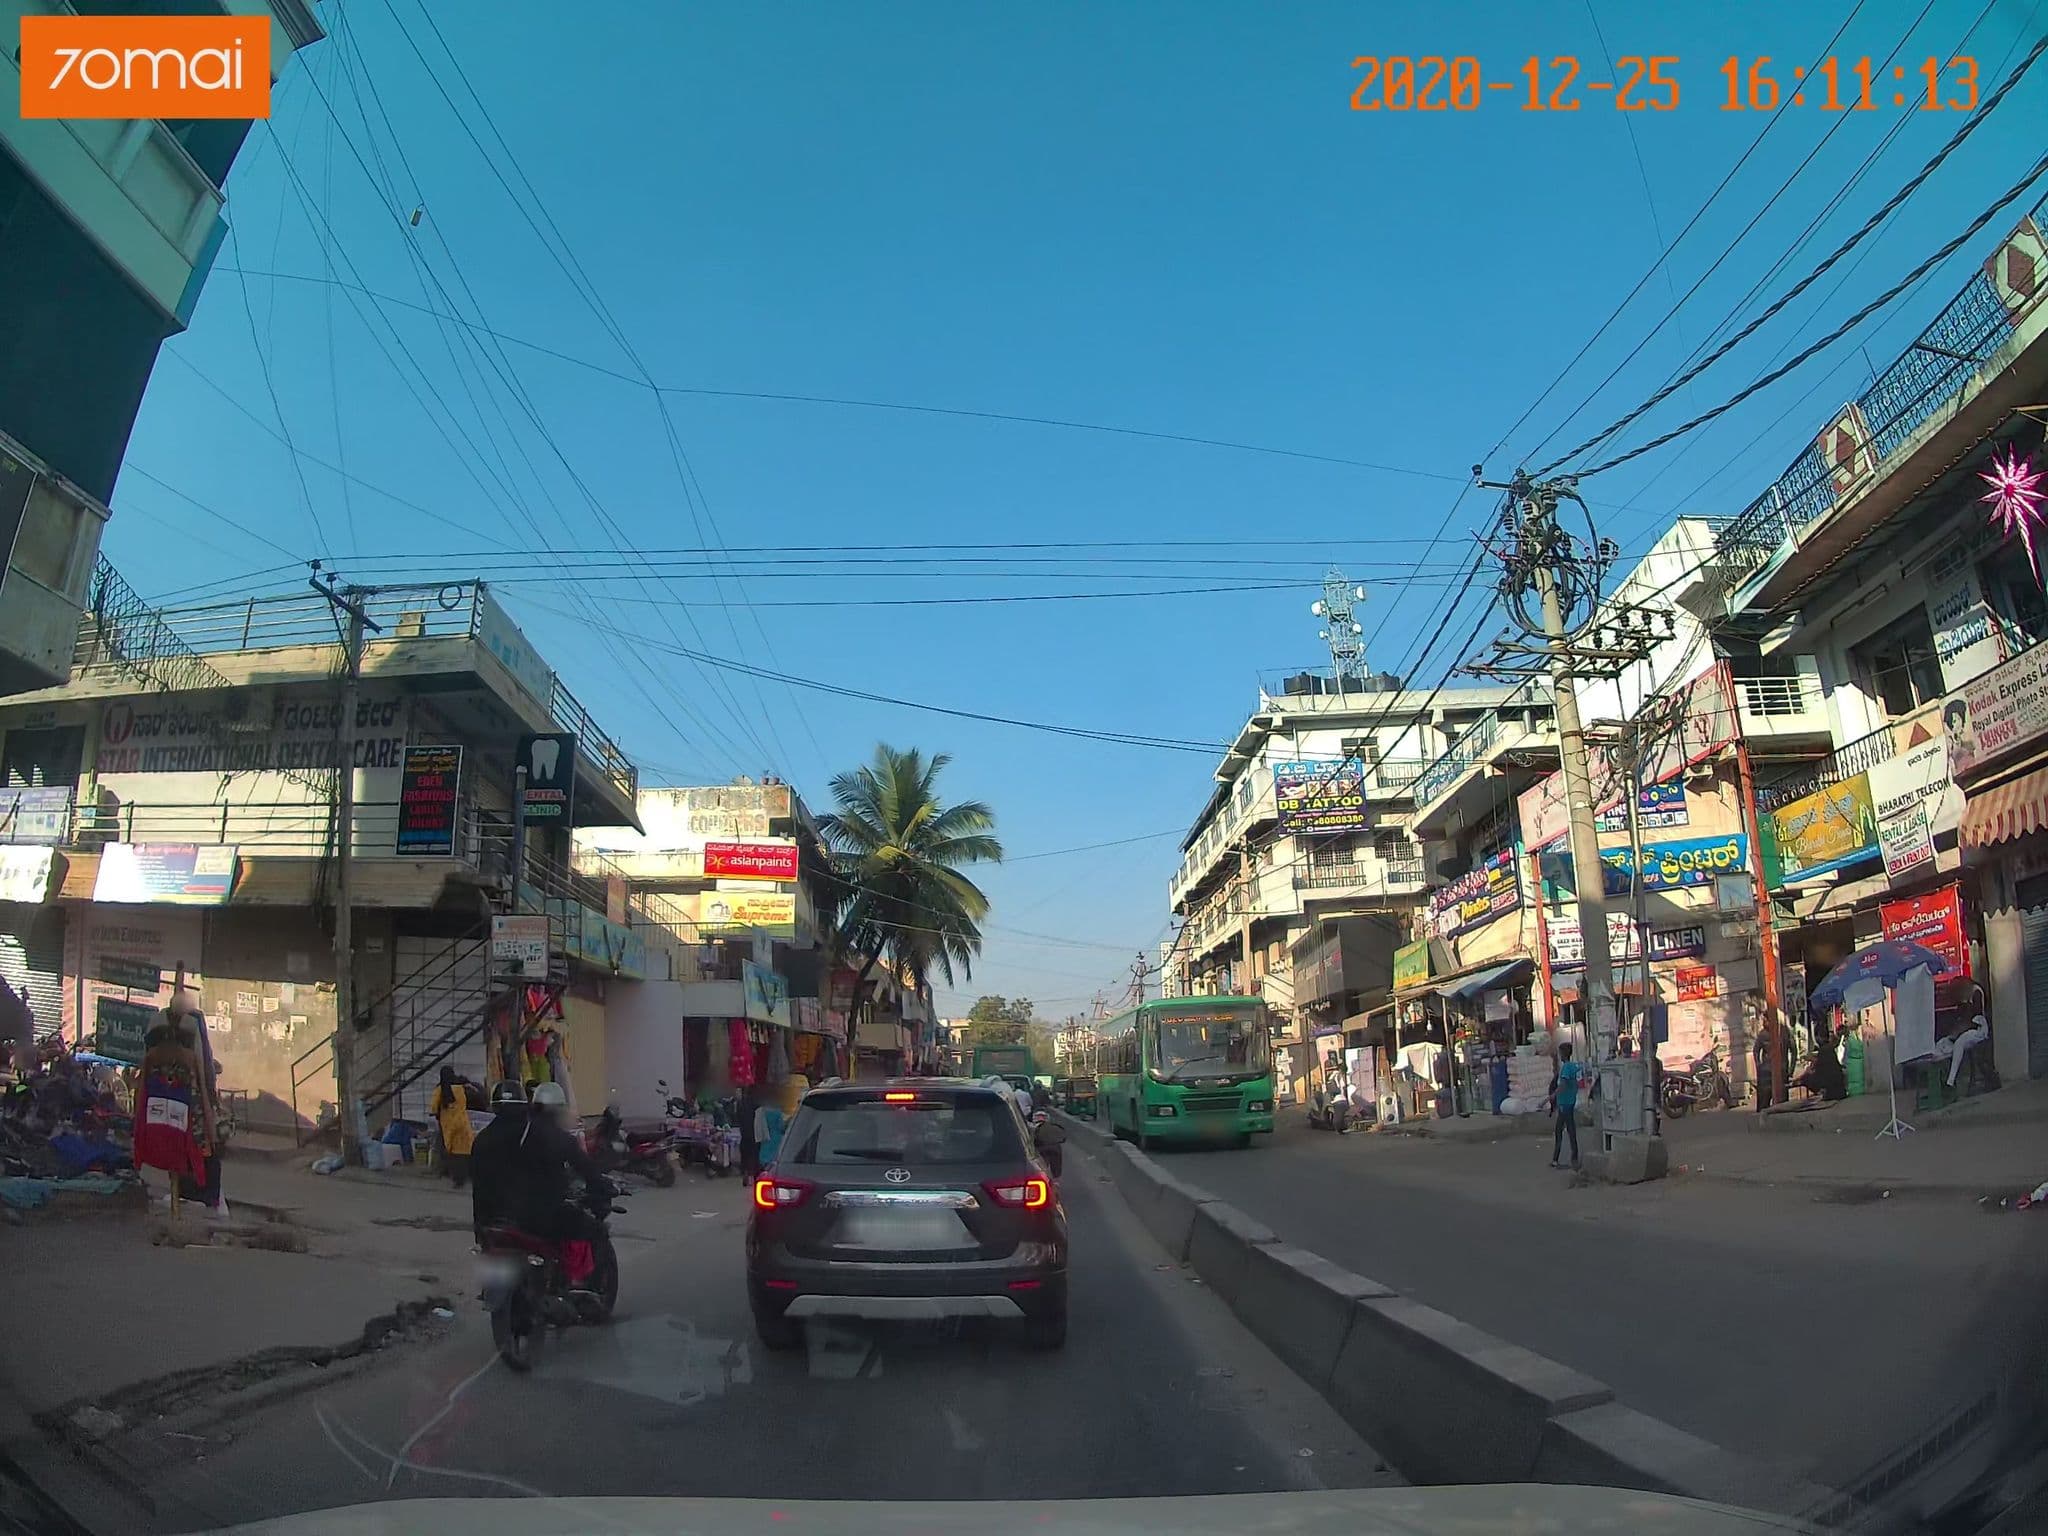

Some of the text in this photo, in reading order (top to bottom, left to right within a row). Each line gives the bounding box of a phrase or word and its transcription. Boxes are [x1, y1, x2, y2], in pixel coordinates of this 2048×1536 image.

[1967, 689, 1999, 716] Kodak
[1998, 669, 2039, 699] Express
[1971, 712, 1992, 733] Royal
[1992, 700, 2017, 723] Digital
[2016, 690, 2038, 711] Photo
[97, 748, 140, 770] STAR
[144, 743, 272, 770] INTERNATIONAL
[354, 737, 402, 768] CARE
[1278, 795, 1364, 810] DB TATTOO
[1877, 776, 1951, 815] BHARATHI TELECOM
[730, 855, 793, 871] asianpaints
[1652, 928, 1704, 951] LINEN
